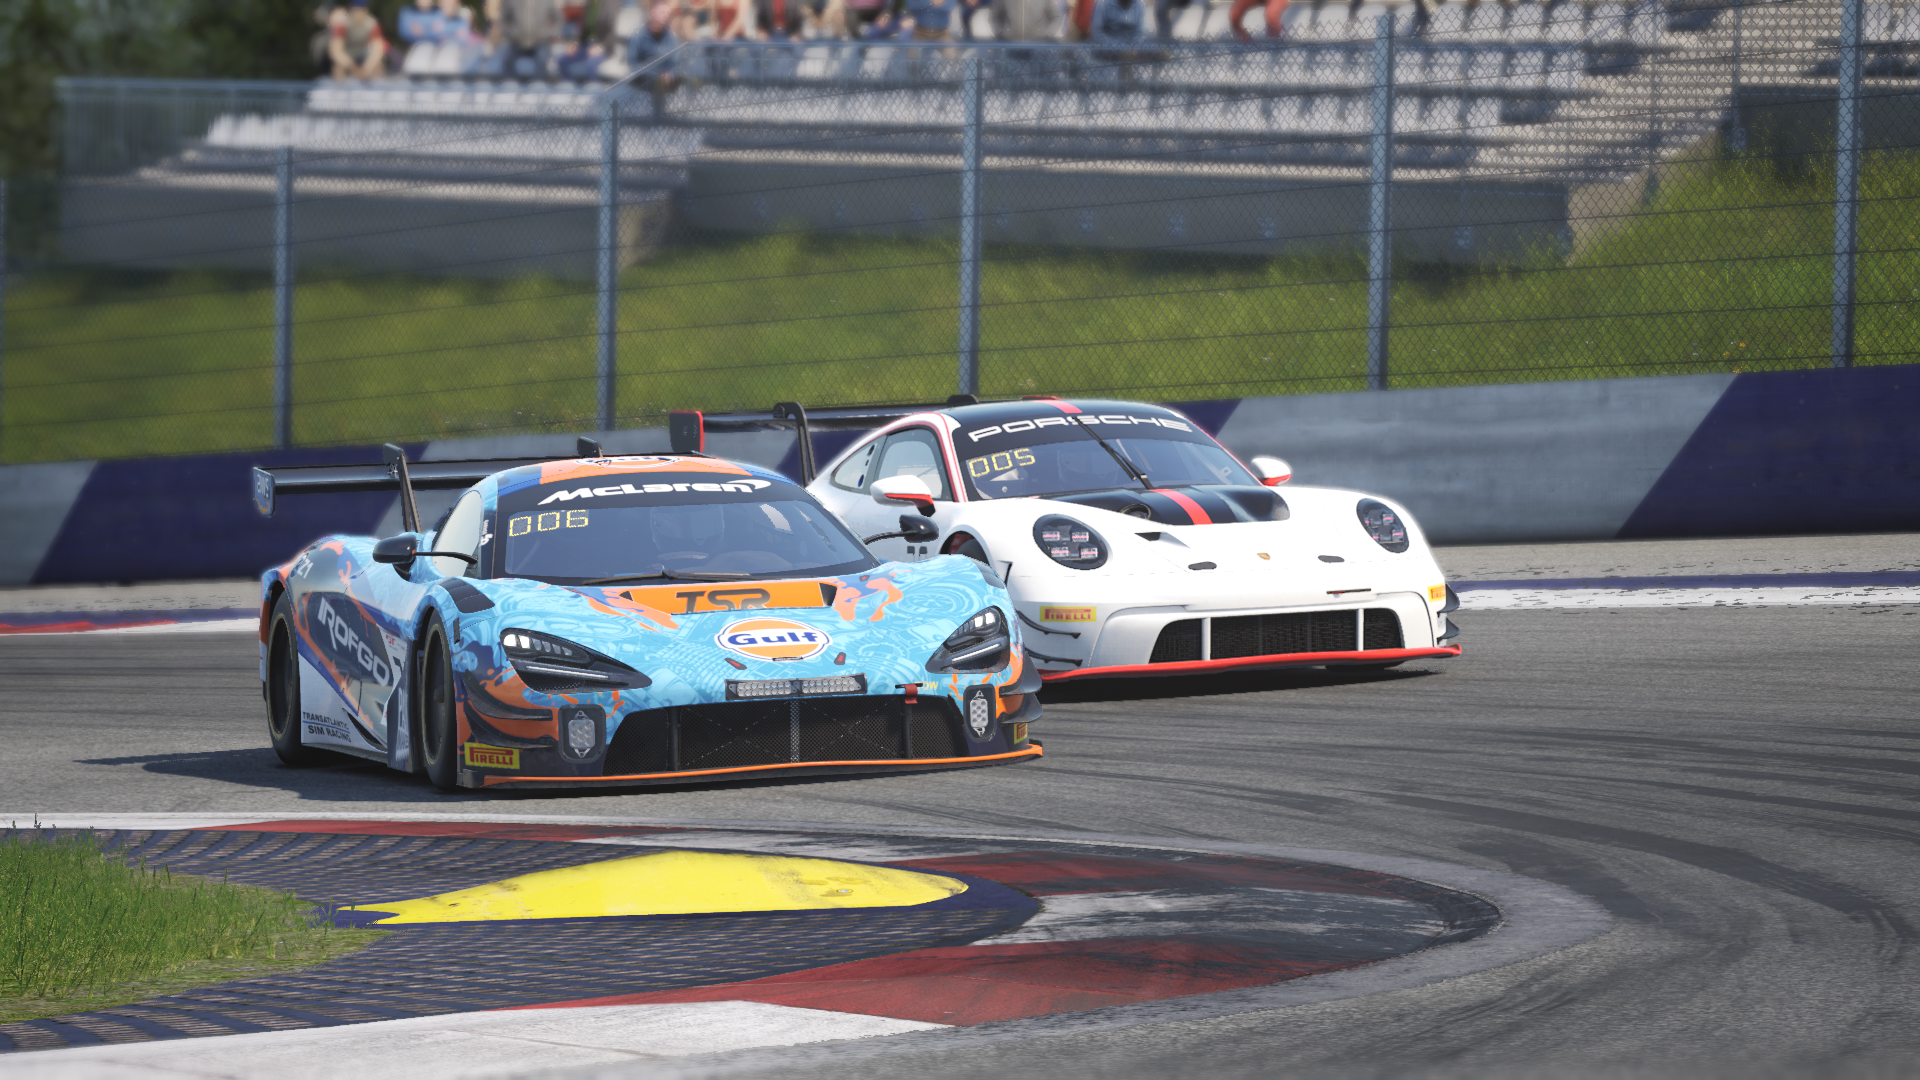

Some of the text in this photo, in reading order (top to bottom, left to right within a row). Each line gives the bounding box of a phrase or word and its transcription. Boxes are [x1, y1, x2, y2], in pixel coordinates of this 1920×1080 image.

[968, 415, 1193, 442] PORSCHE
[968, 448, 1036, 477] 005
[537, 479, 772, 505] McLaren
[508, 509, 589, 537] 006
[675, 588, 771, 613] TSR
[1044, 608, 1092, 620] PIRELLI
[727, 631, 819, 646] Gulf
[307, 725, 352, 743] SIM RACING
[469, 746, 514, 766] PIRELLI
